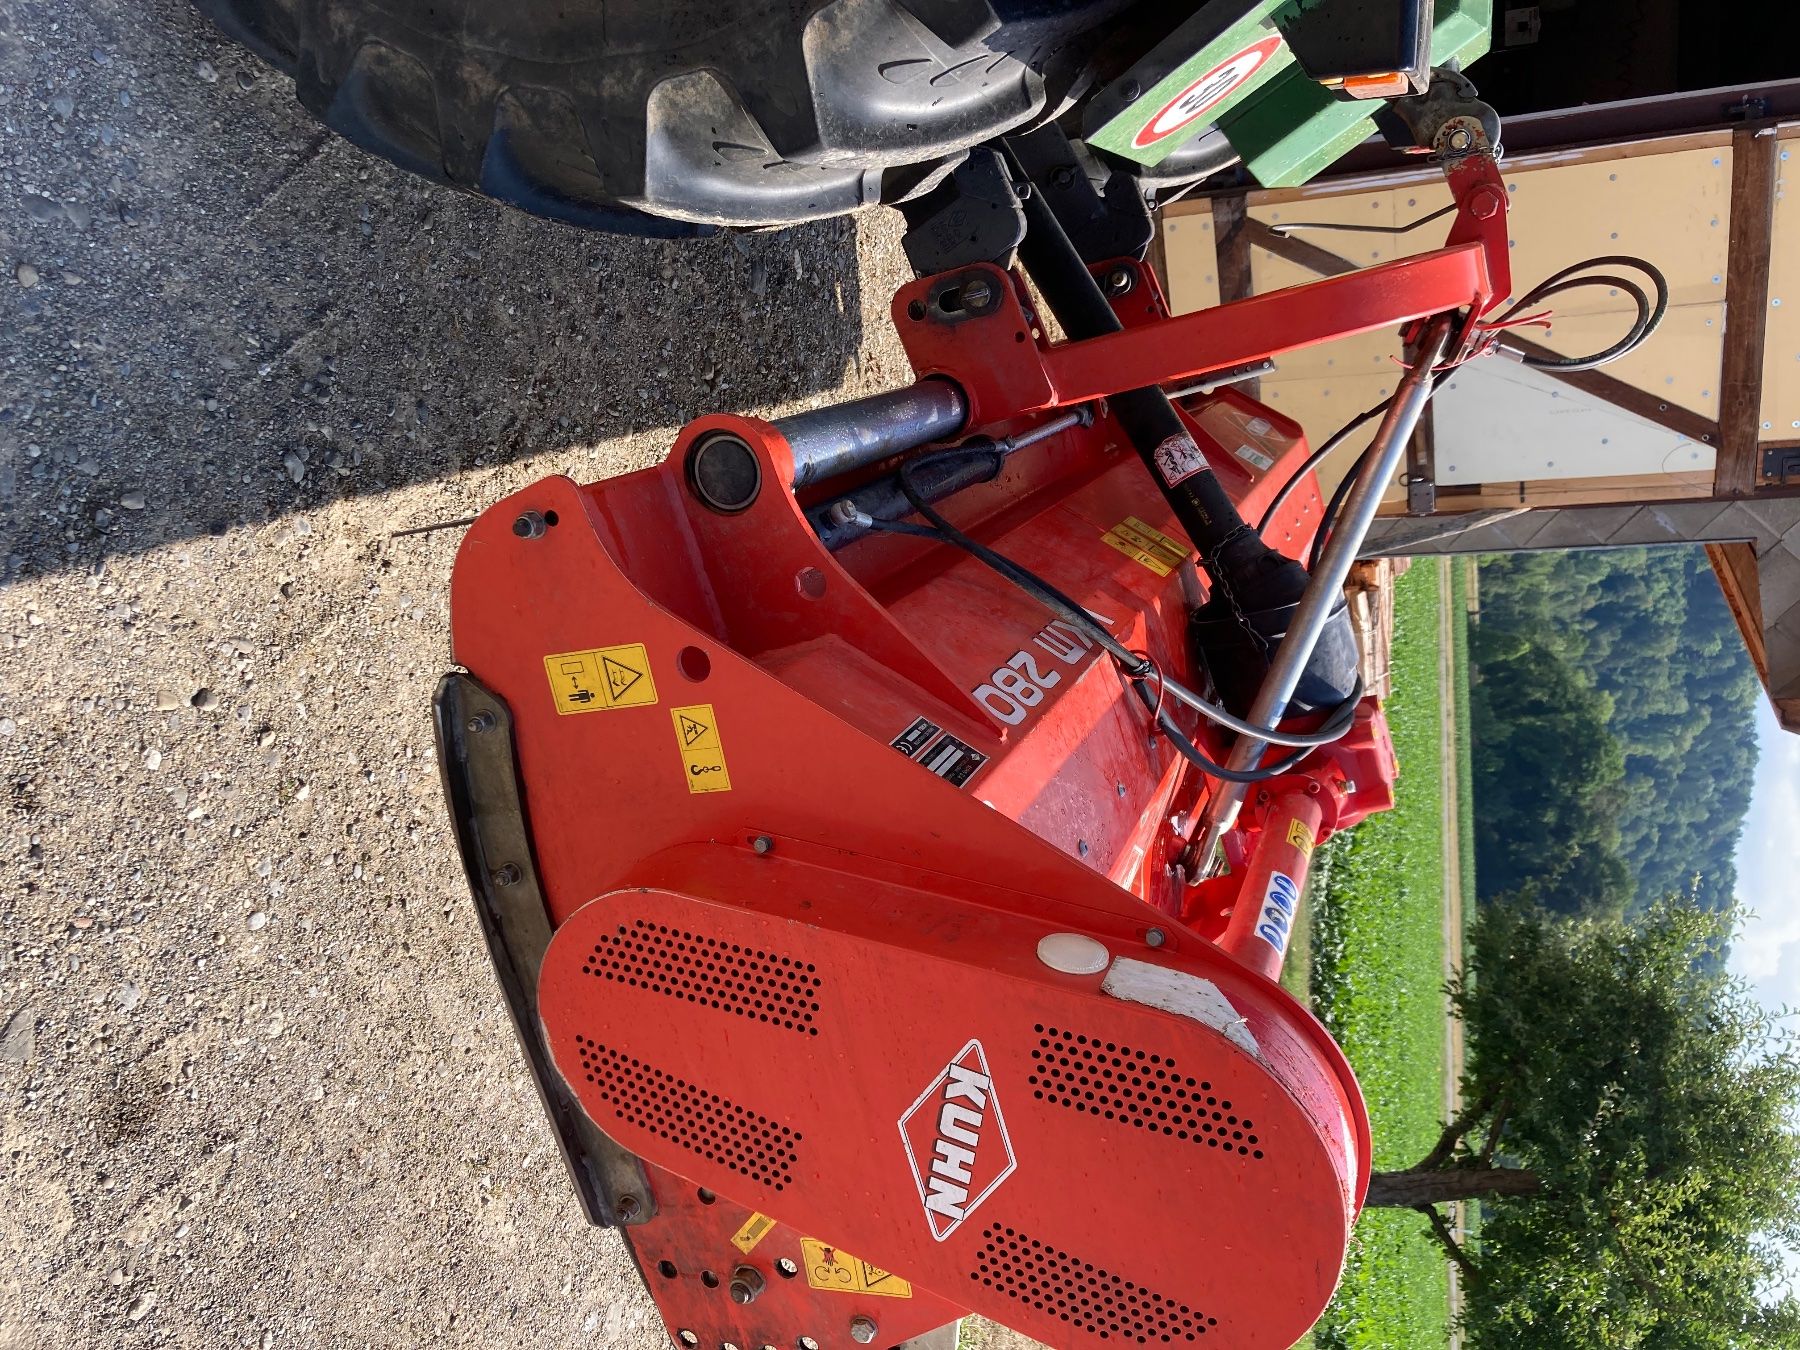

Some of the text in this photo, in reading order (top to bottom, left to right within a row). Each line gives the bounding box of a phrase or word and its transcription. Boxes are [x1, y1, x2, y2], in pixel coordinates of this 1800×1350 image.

[1179, 66, 1239, 114] 30
[972, 650, 1061, 725] 280
[924, 1062, 991, 1221] KUHN
